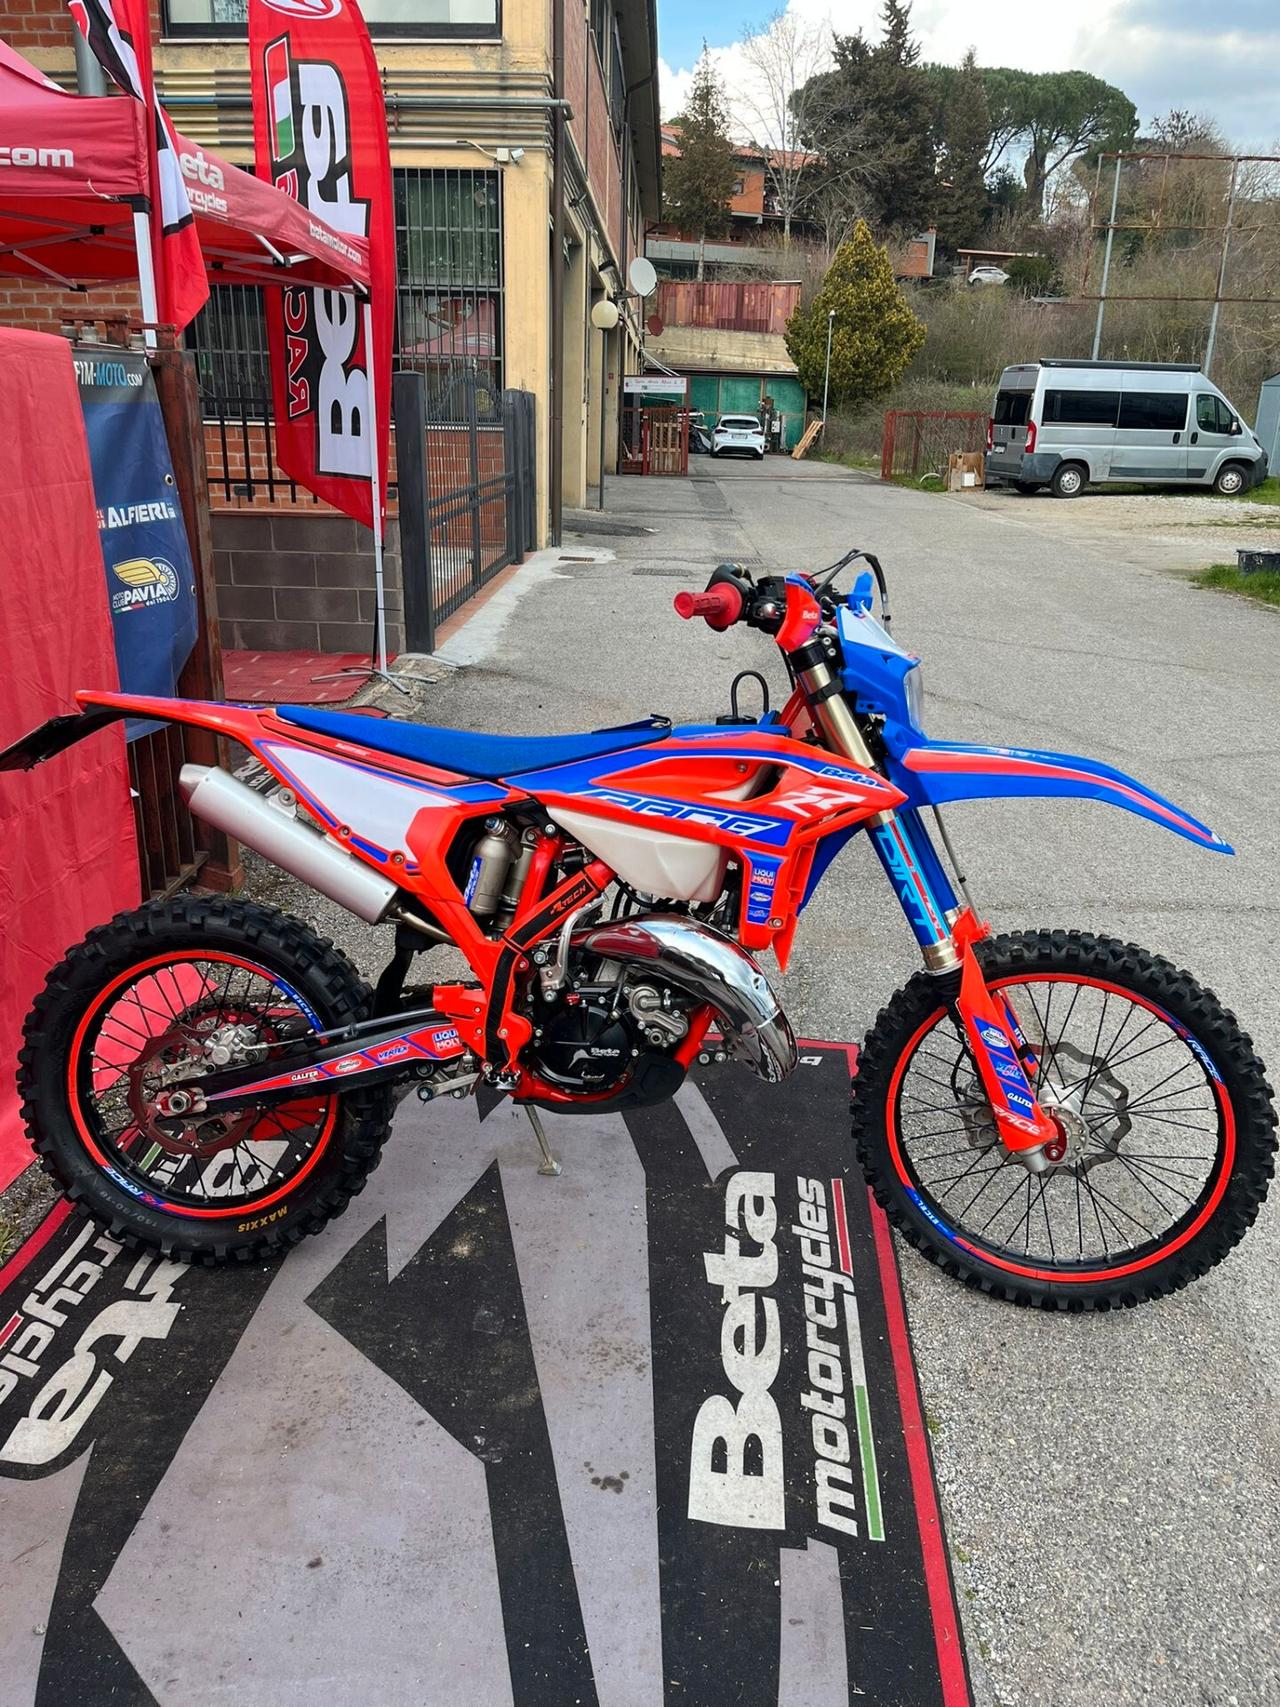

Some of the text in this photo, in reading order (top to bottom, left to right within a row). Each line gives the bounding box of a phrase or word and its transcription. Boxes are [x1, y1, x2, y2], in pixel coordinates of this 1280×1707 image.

[180, 152, 224, 191] eta
[108, 502, 169, 529] ALFIERI
[124, 583, 168, 605] PAVIA
[802, 610, 818, 620] Beta
[821, 767, 877, 786] Beta
[751, 876, 775, 886] MOLY
[753, 868, 774, 878] LIQUI
[378, 1045, 408, 1060] VERTEX
[436, 1037, 461, 1050] MOLY
[291, 1070, 319, 1082] GALFER
[238, 1204, 288, 1233] MAXXIS
[687, 1171, 786, 1531] Beta
[791, 1175, 859, 1537] motorcycles
